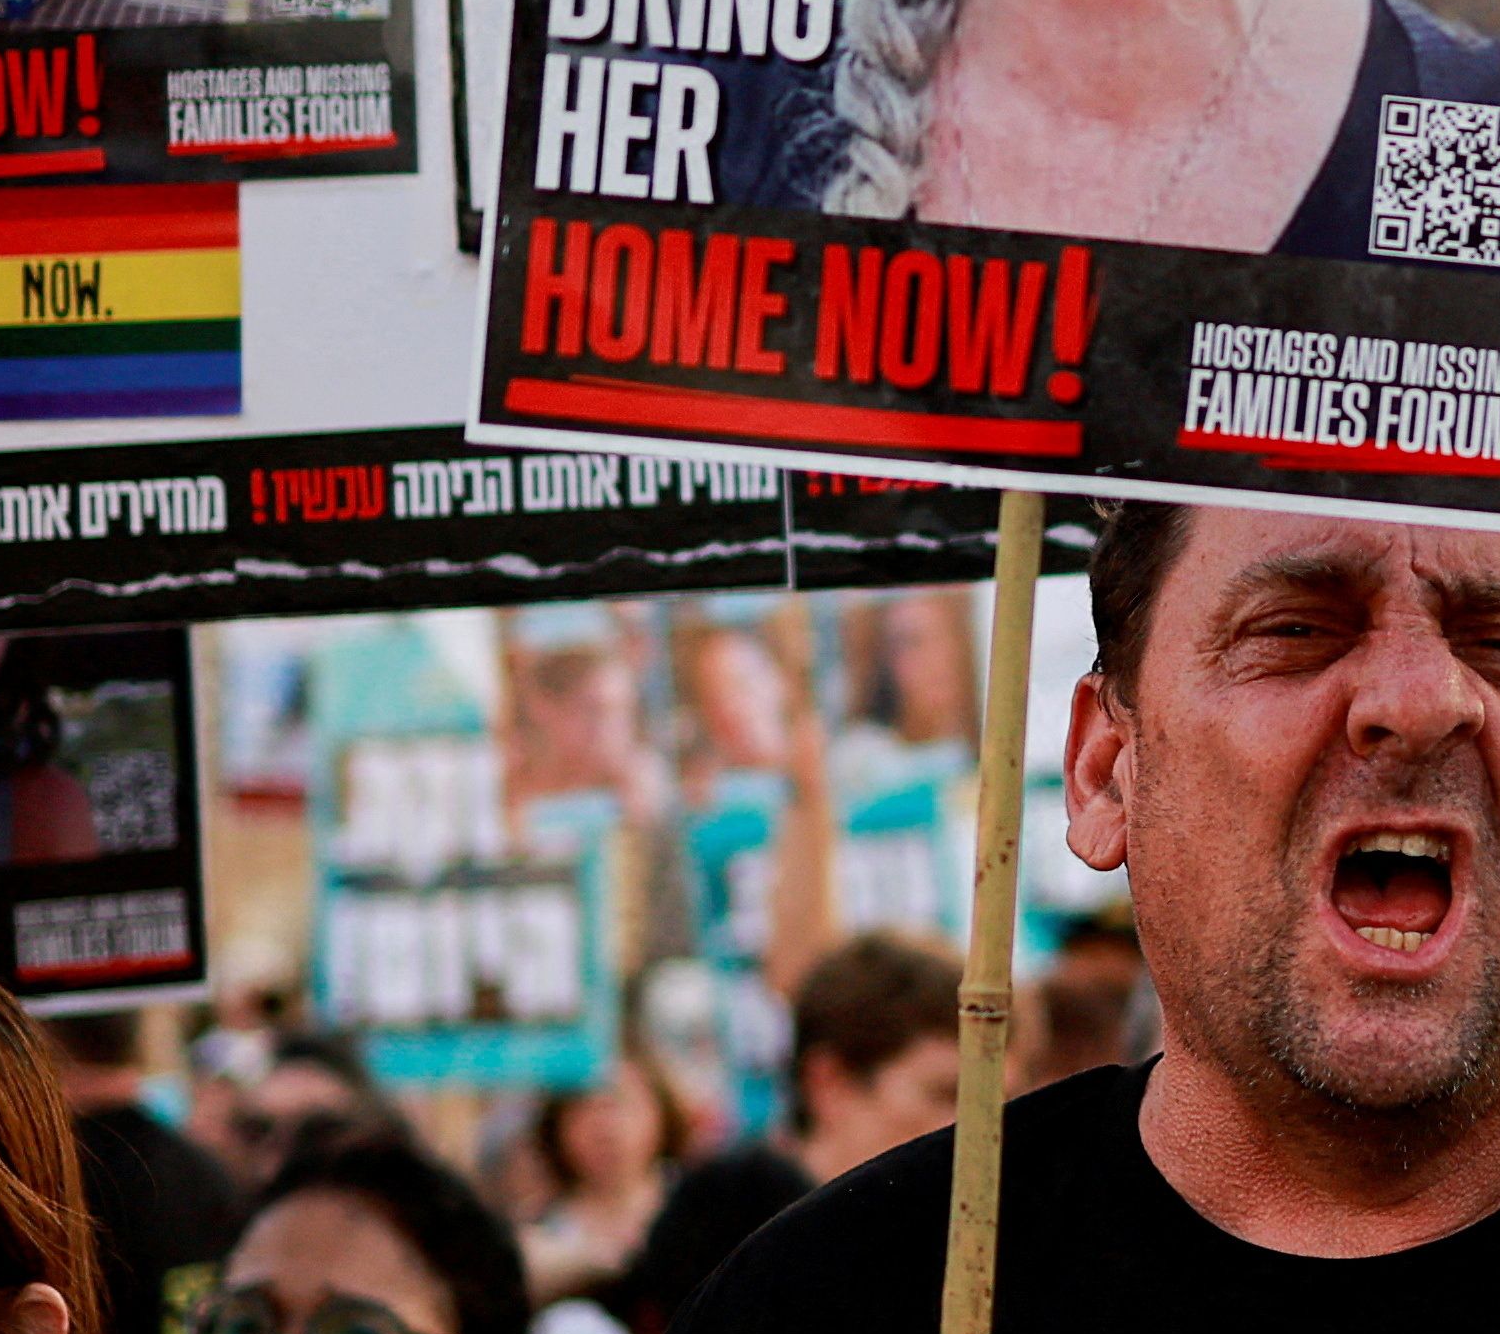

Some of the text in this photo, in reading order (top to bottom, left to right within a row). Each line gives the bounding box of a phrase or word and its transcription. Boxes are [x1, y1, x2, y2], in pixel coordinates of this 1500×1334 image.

[167, 63, 391, 99] HOSTAGES AND MISSING
[168, 94, 392, 146] FAMILIES FORUM
[535, 53, 721, 206] HER
[21, 261, 113, 321] NOW.
[522, 219, 1099, 405] HOME NOW!
[1190, 321, 1338, 378] HOSTAGES
[1338, 335, 1399, 383] AND
[1184, 368, 1371, 448] FAMILIES
[79, 476, 227, 538] מחזירים
[392, 457, 513, 518] הביתה
